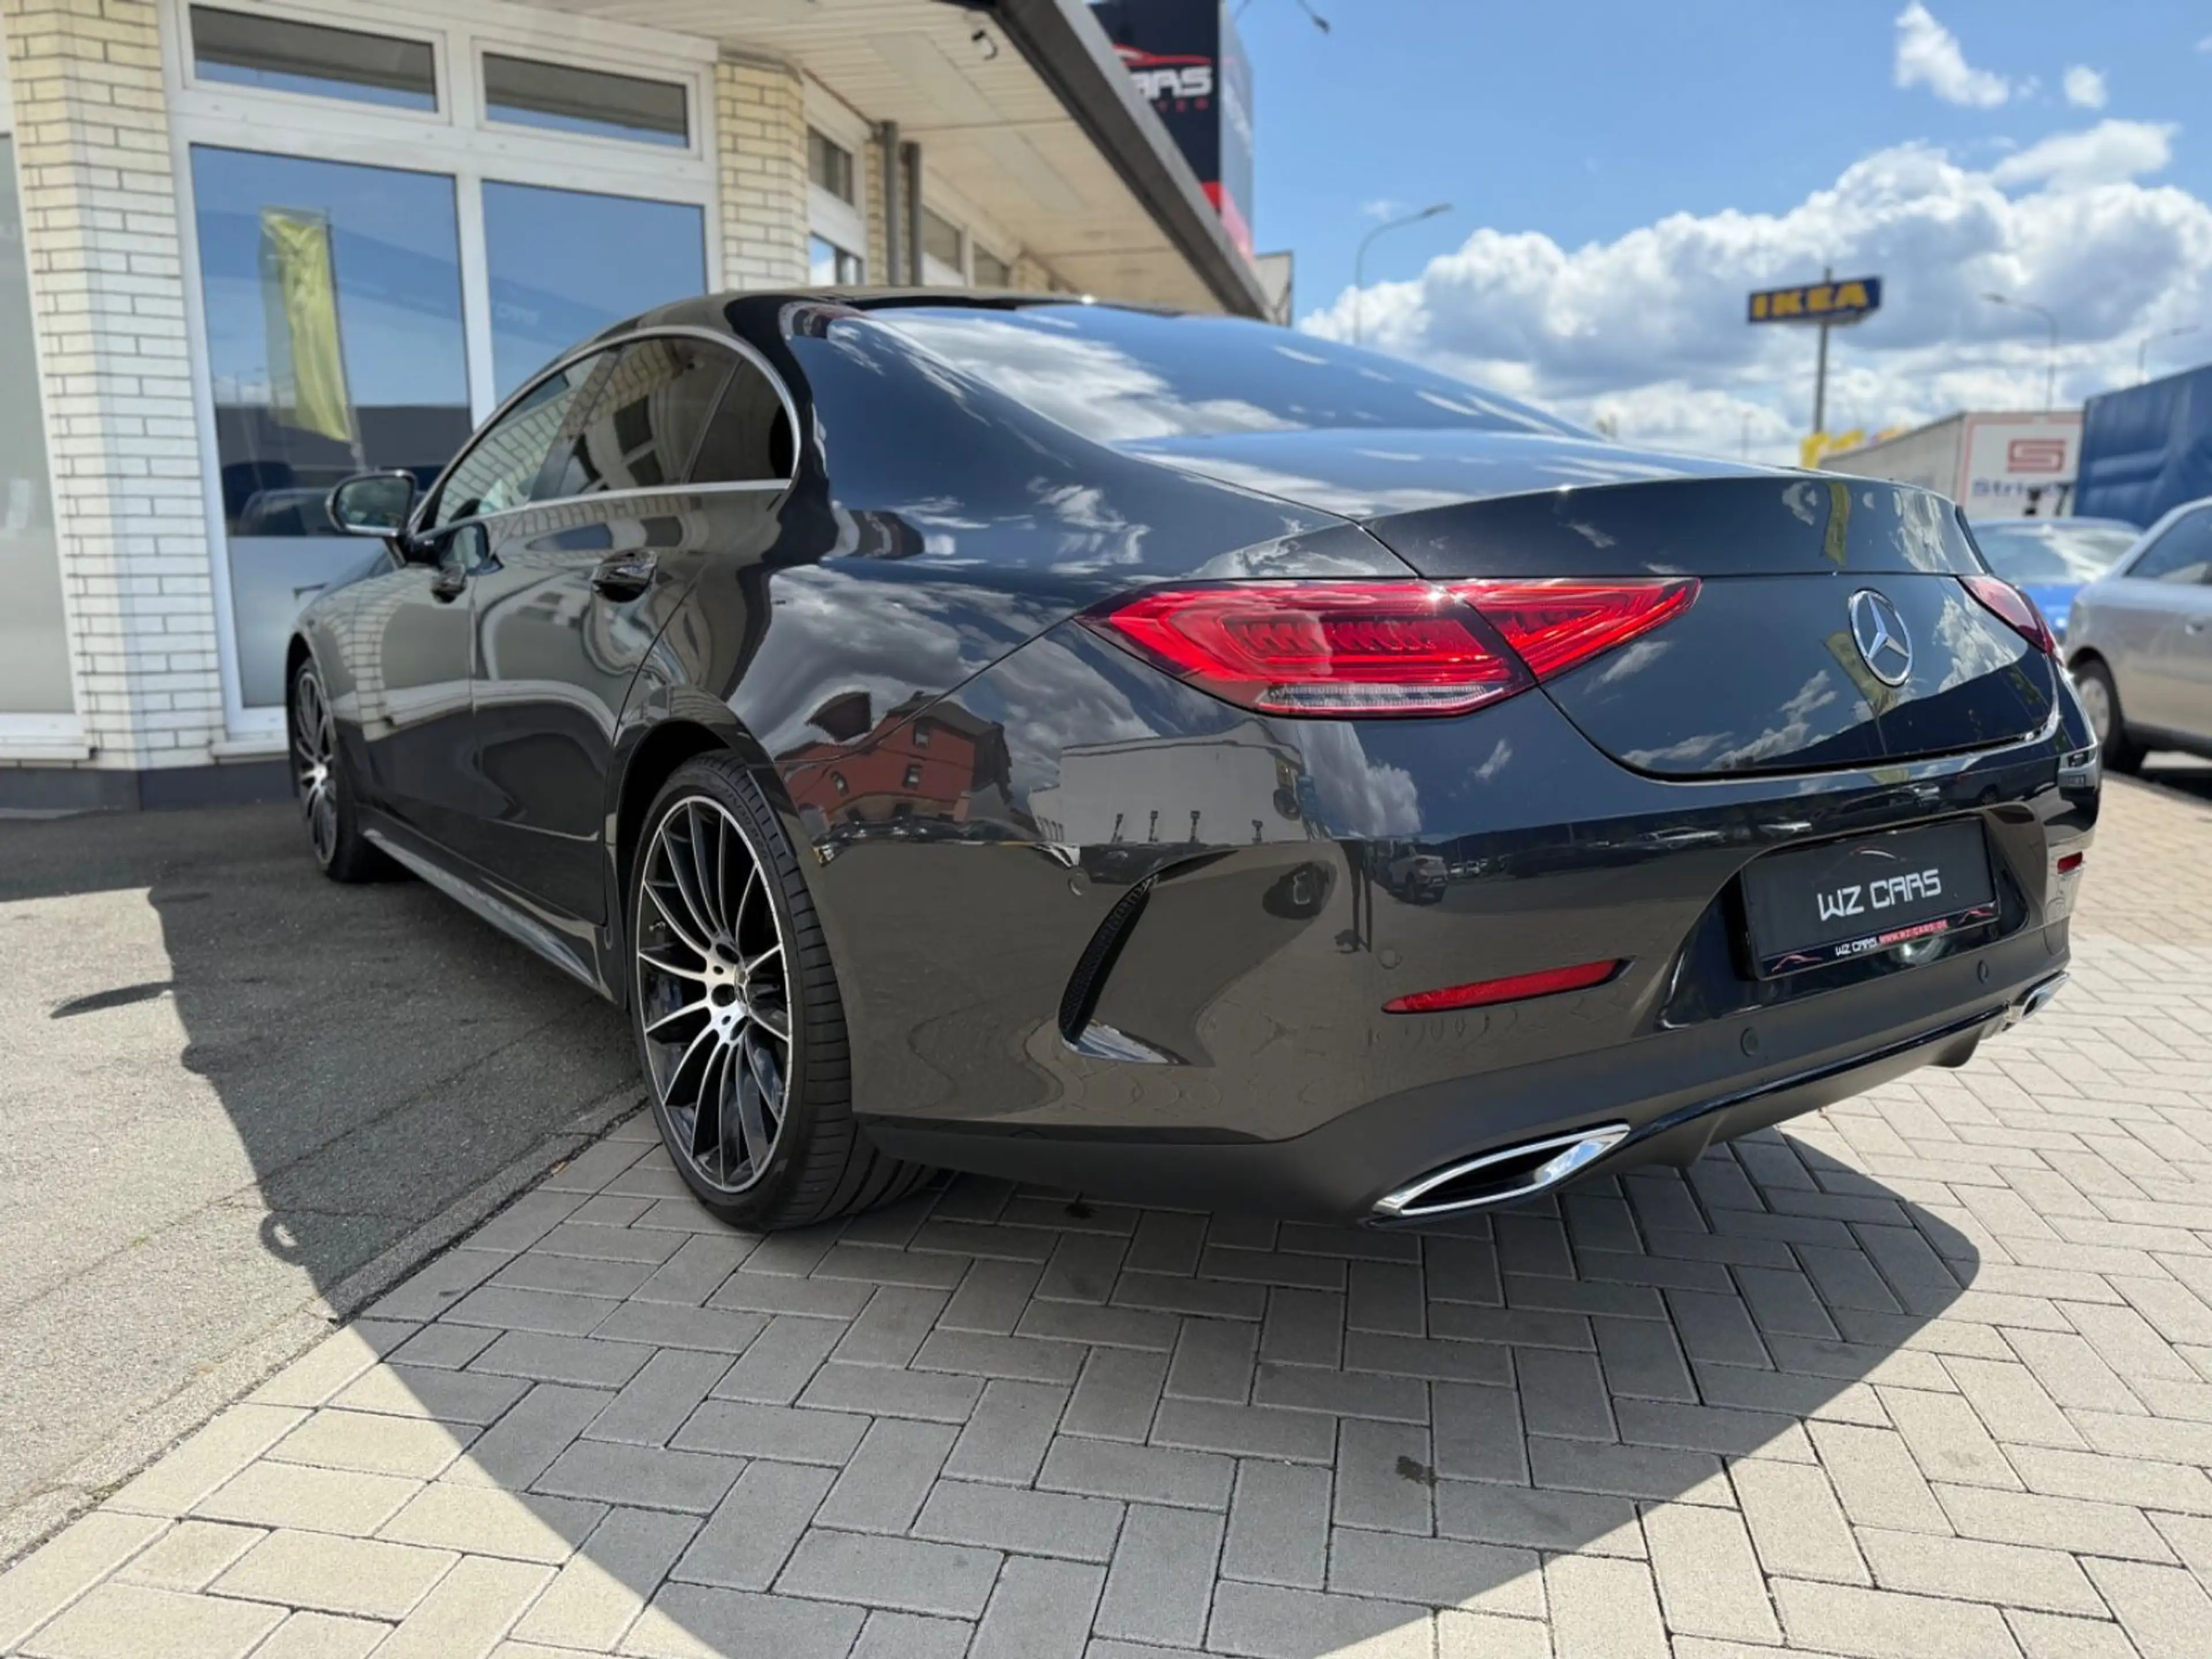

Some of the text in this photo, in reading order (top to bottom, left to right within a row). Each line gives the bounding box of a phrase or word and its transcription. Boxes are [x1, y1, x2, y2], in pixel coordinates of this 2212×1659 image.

[1131, 66, 1212, 98] ARS
[1752, 281, 1868, 319] IKEA
[1817, 869, 1941, 921] WZ CARS
[1835, 943, 1852, 956] WZ
